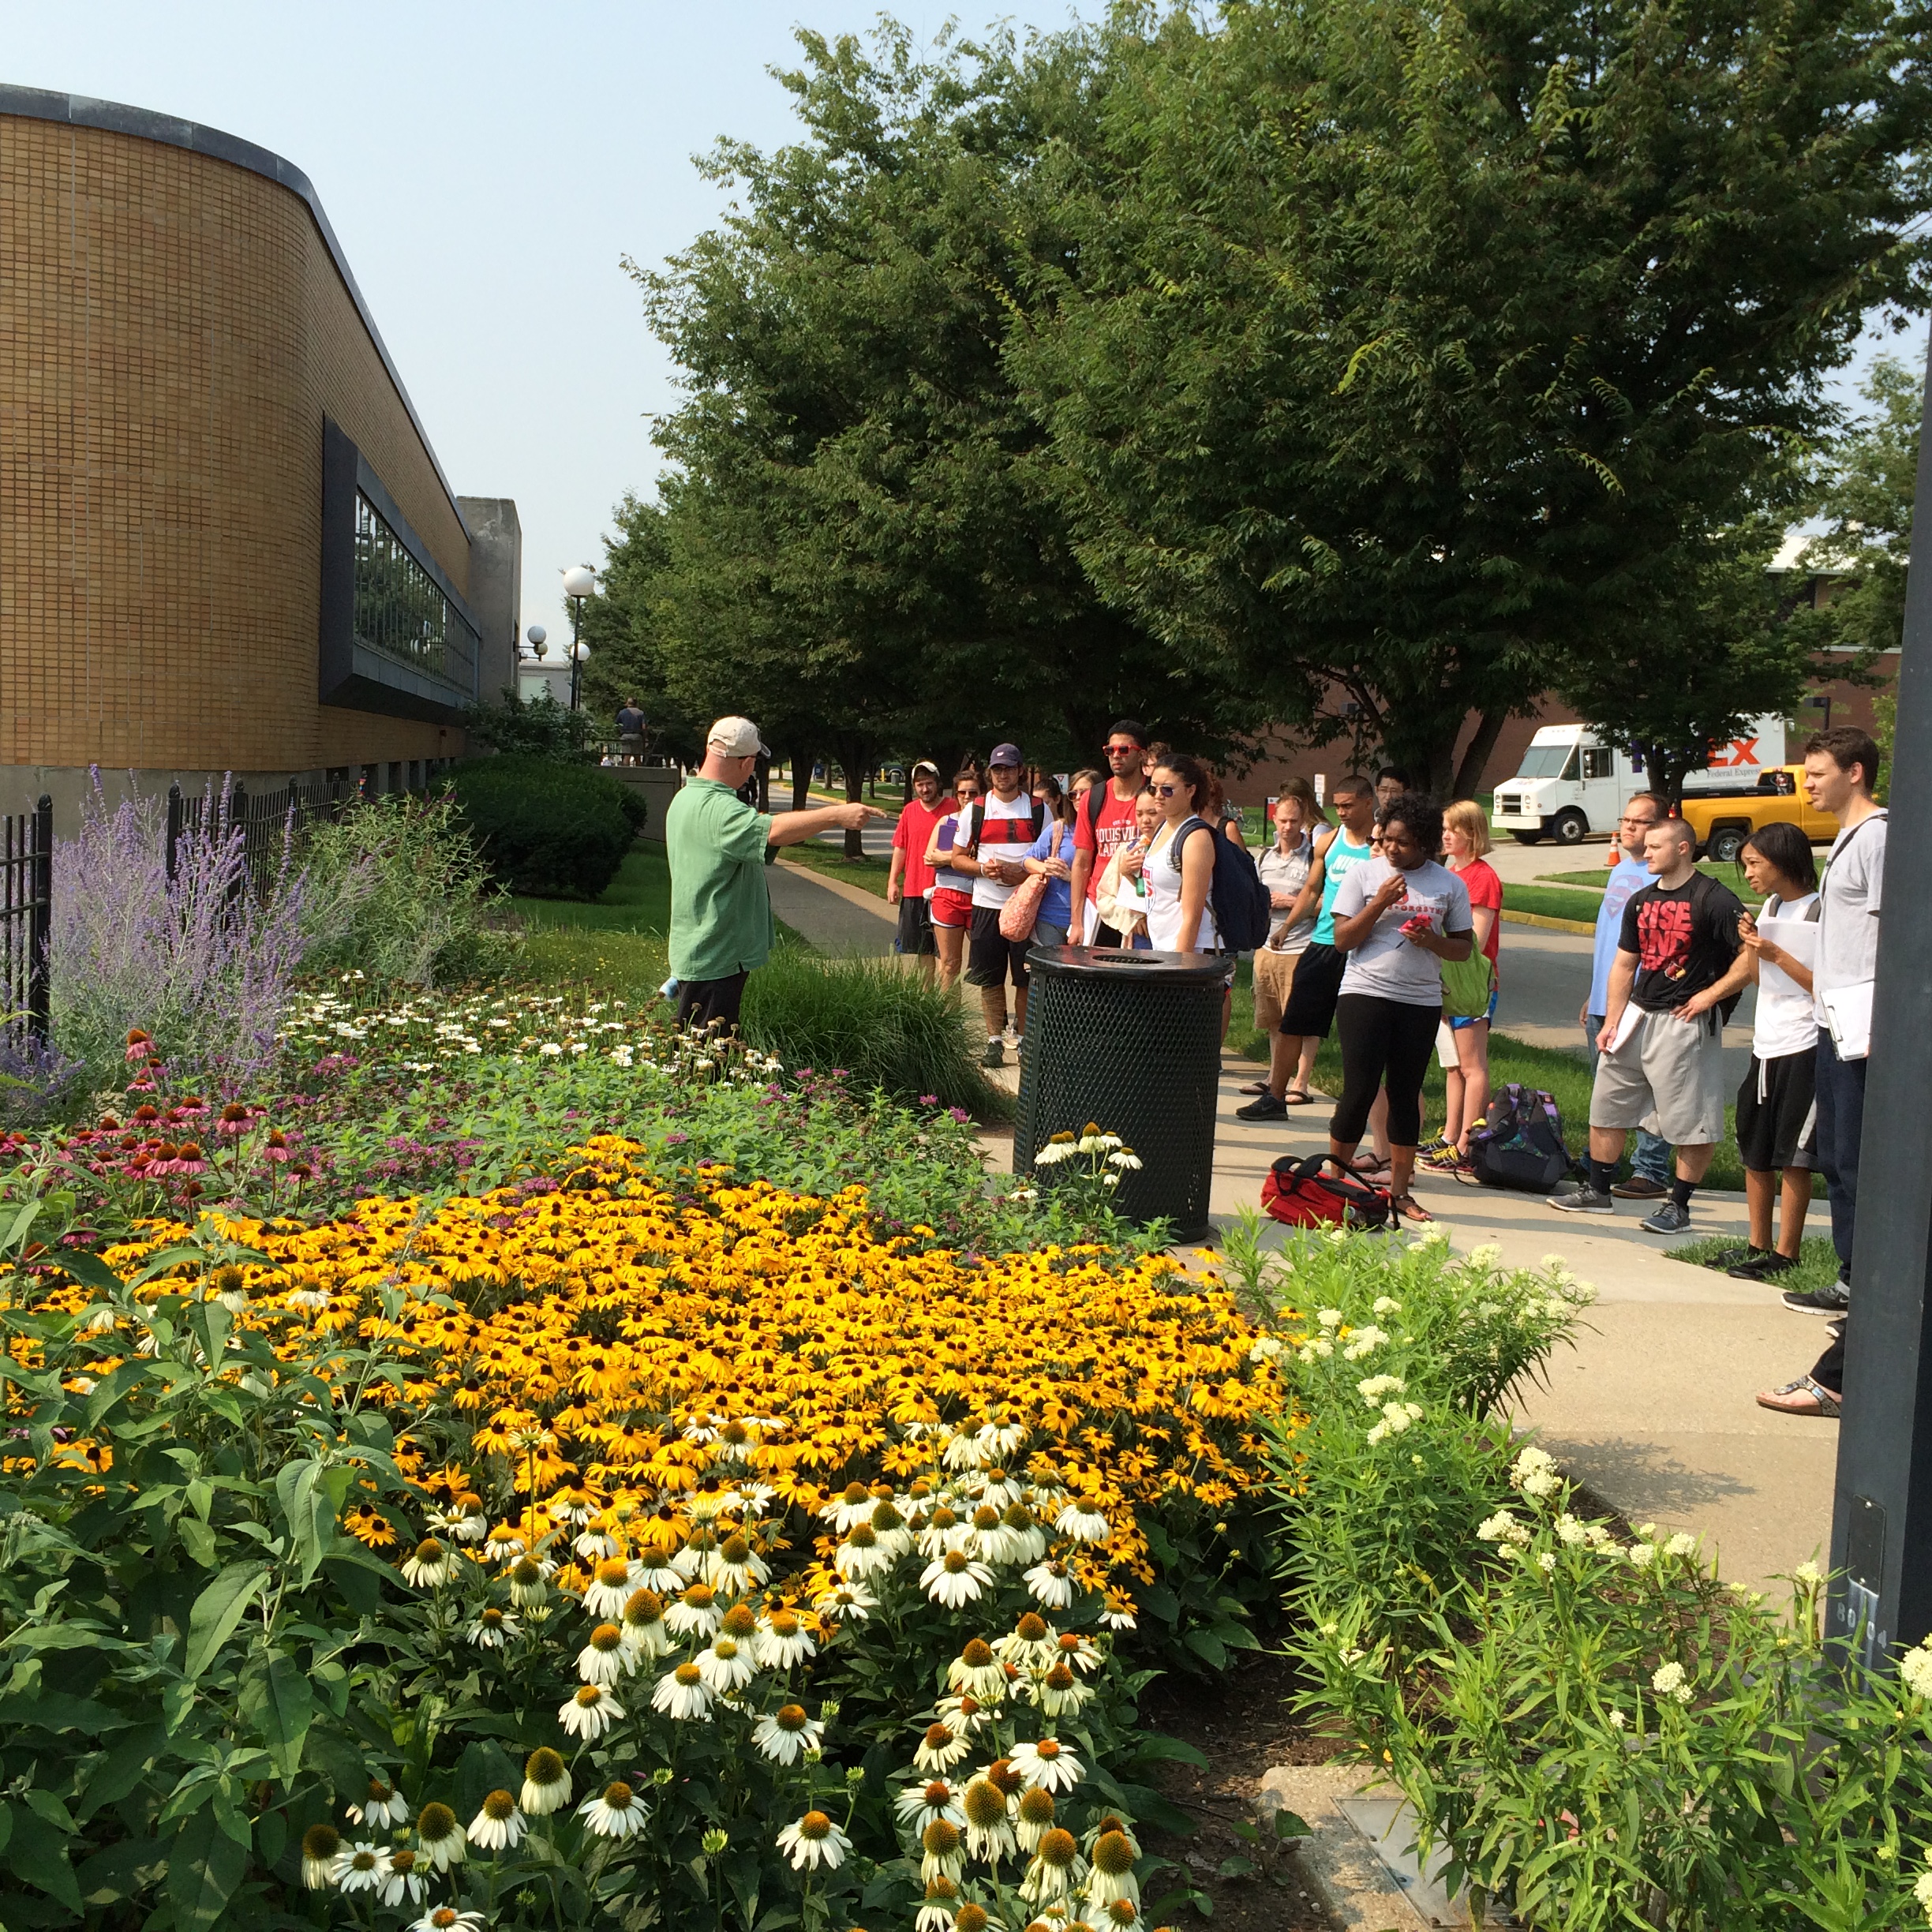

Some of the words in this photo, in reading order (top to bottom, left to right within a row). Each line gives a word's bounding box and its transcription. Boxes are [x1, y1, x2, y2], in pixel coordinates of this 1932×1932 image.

[1707, 769, 1732, 778] Federal
[1095, 826, 1141, 843] LOUISVILL
[1332, 854, 1365, 871] NIK
[1290, 867, 1305, 880] NY
